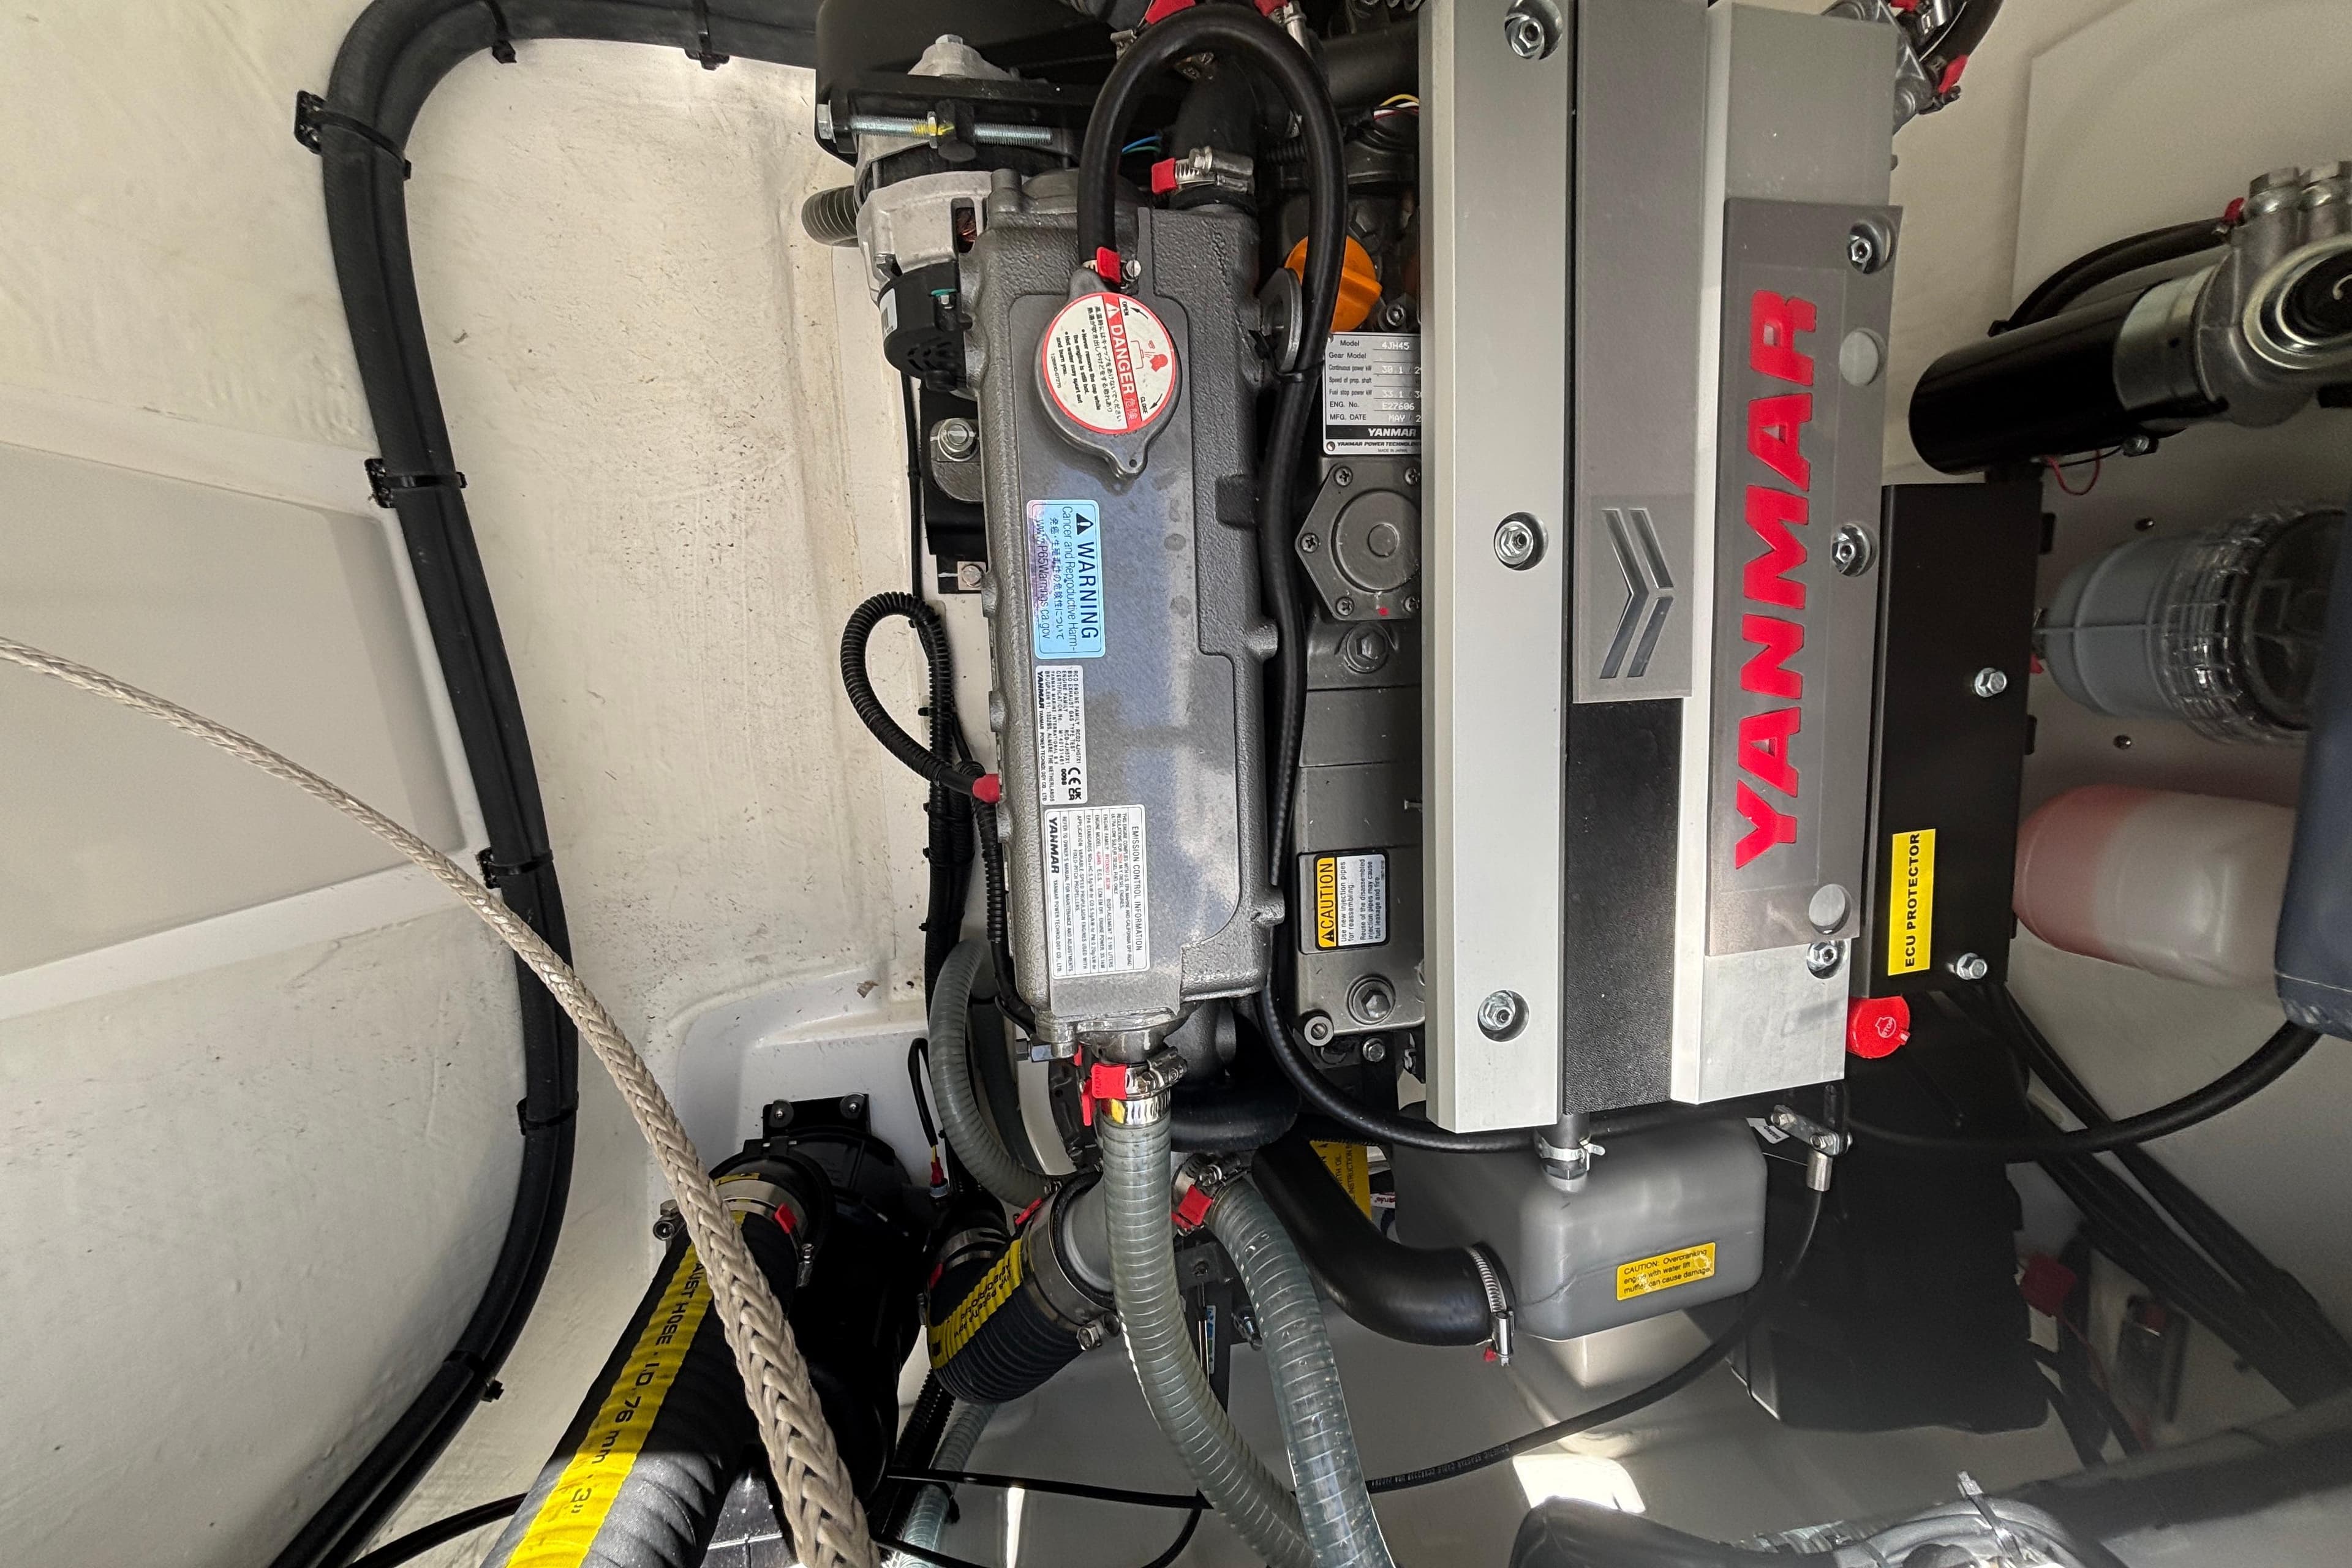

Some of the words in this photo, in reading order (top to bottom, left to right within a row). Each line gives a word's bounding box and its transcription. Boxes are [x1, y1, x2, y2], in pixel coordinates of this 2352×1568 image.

[1110, 325, 1134, 394] DANGER
[1124, 398, 1138, 420] 危険
[1062, 507, 1073, 538] Cancer
[1065, 541, 1074, 559] and
[1035, 519, 1050, 639] www.P65Warnings.ca.gov
[1064, 562, 1077, 619] Reproductive
[1077, 541, 1098, 638] WARNING
[1735, 290, 1817, 870] YANMAR
[1049, 817, 1060, 873] YANMAR
[1319, 864, 1334, 929] CAUTION
[1906, 832, 1921, 930] PROTECTOR
[1904, 938, 1915, 967] ECU
[1882, 1018, 1893, 1036] STOP
[1624, 1274, 1646, 1284] engine
[1648, 1269, 1661, 1278] with
[1663, 1264, 1681, 1273] water
[1663, 1250, 1707, 1264] Overcranking
[680, 1261, 704, 1298] AUST
[1662, 1274, 1682, 1283] cause
[655, 1302, 689, 1345] HOSE
[615, 1396, 641, 1423] 76
[592, 1430, 621, 1464] mm
